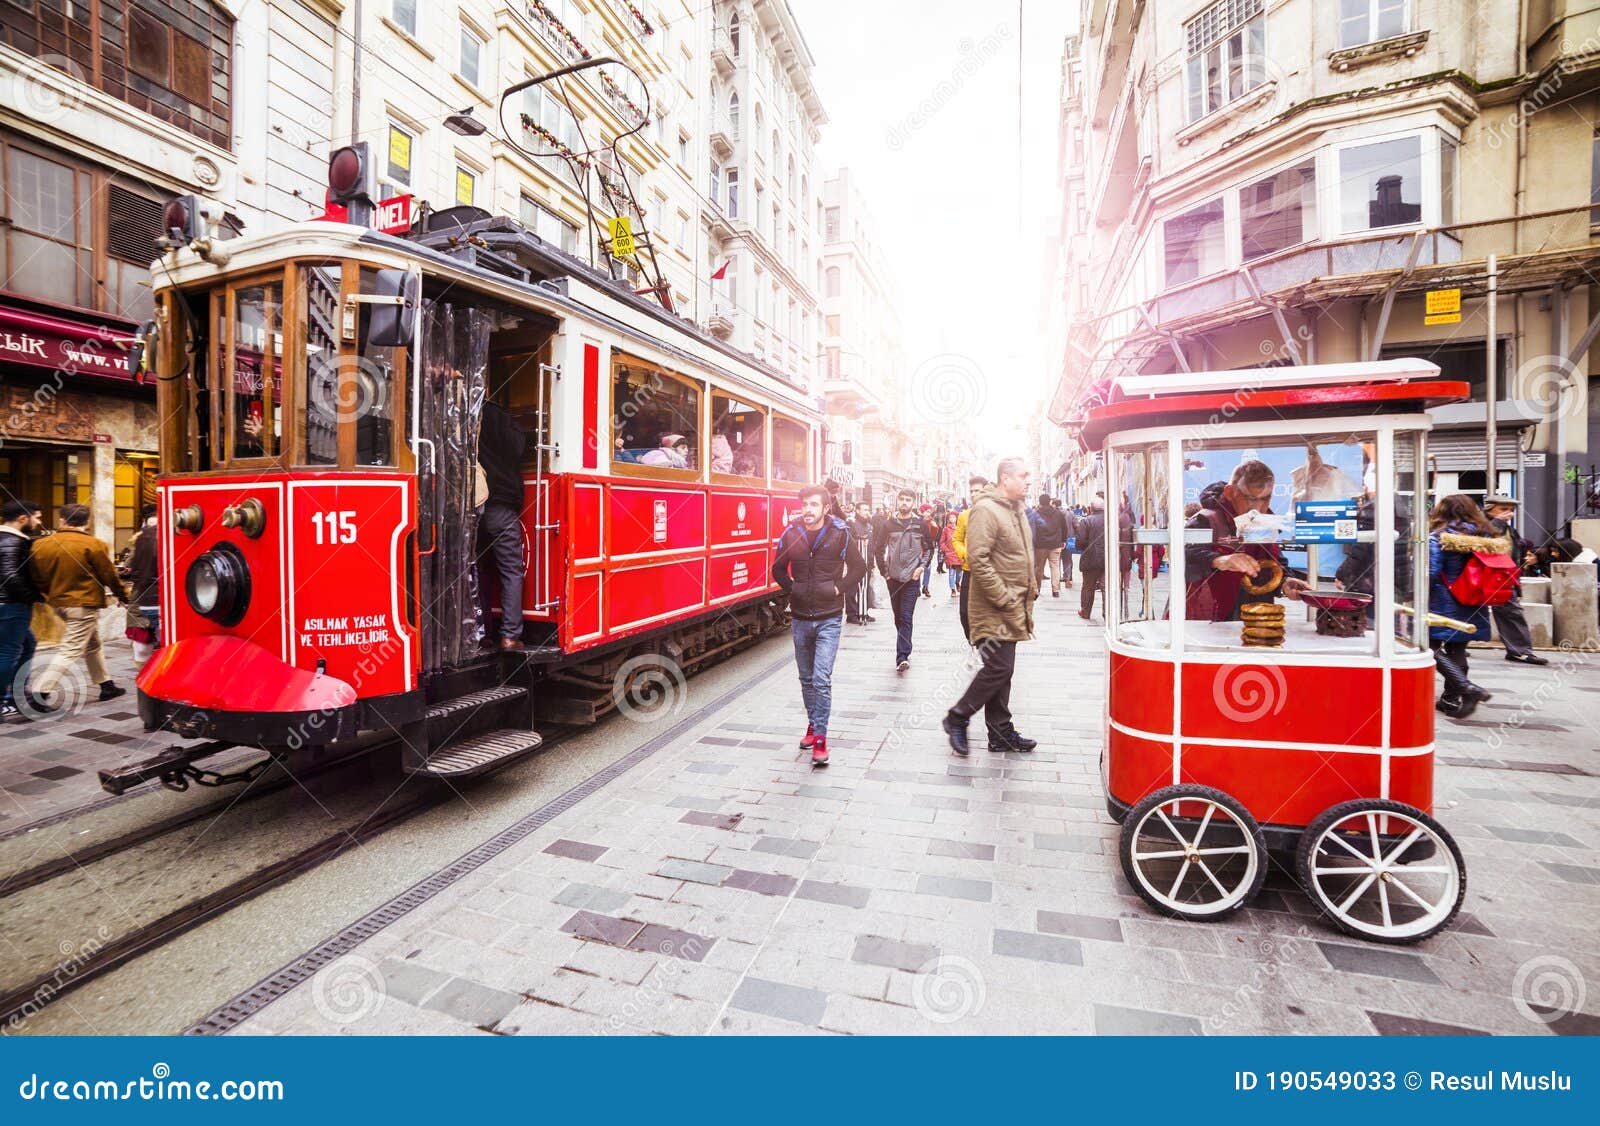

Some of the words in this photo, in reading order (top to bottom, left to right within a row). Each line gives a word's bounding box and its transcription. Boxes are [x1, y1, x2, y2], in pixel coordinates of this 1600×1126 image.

[616, 239, 630, 247] 600
[311, 511, 357, 545] 115
[304, 618, 349, 631] ASILMAK
[353, 614, 386, 629] YASAK
[300, 634, 313, 647] VE
[318, 629, 389, 647] TEHLİKELİDİR
